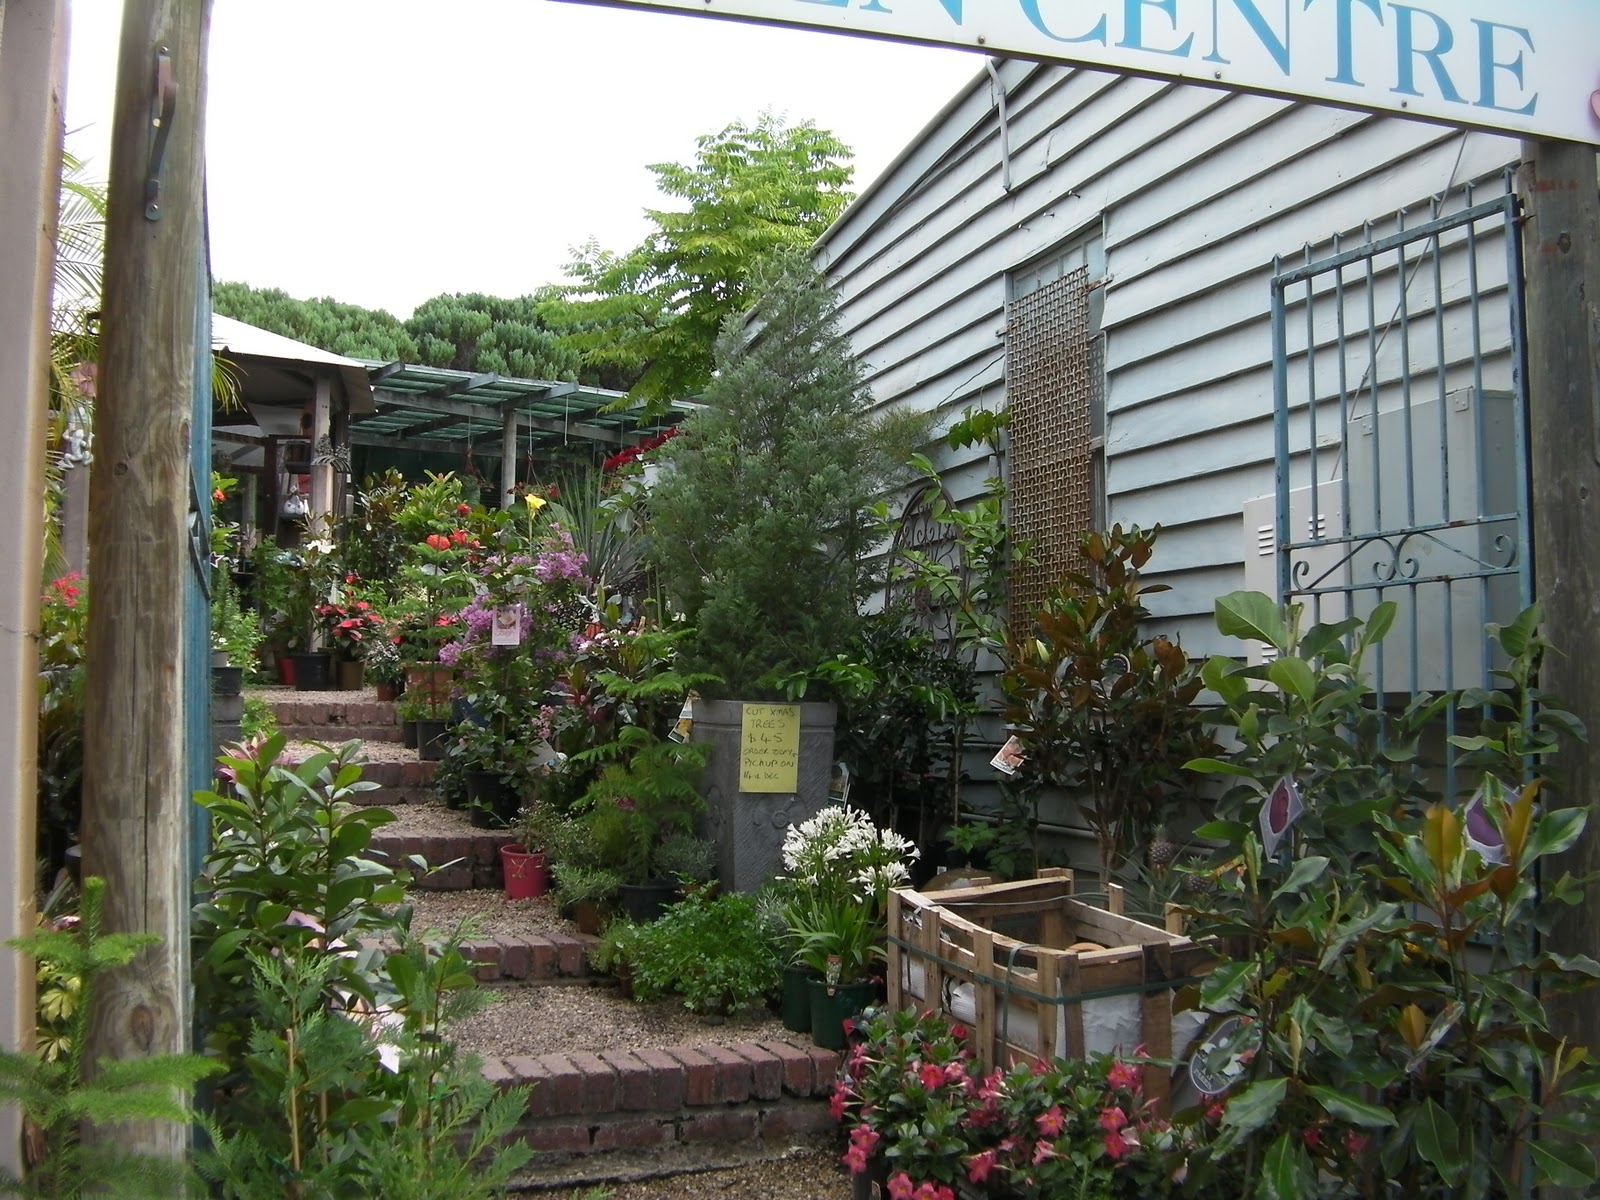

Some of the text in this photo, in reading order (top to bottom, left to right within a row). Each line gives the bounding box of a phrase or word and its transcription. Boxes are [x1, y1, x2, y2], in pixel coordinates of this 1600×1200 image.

[746, 707, 795, 717] CUT XMAS
[751, 719, 786, 729] TREES
[743, 747, 769, 755] ORDER
[764, 771, 780, 779] DEC
